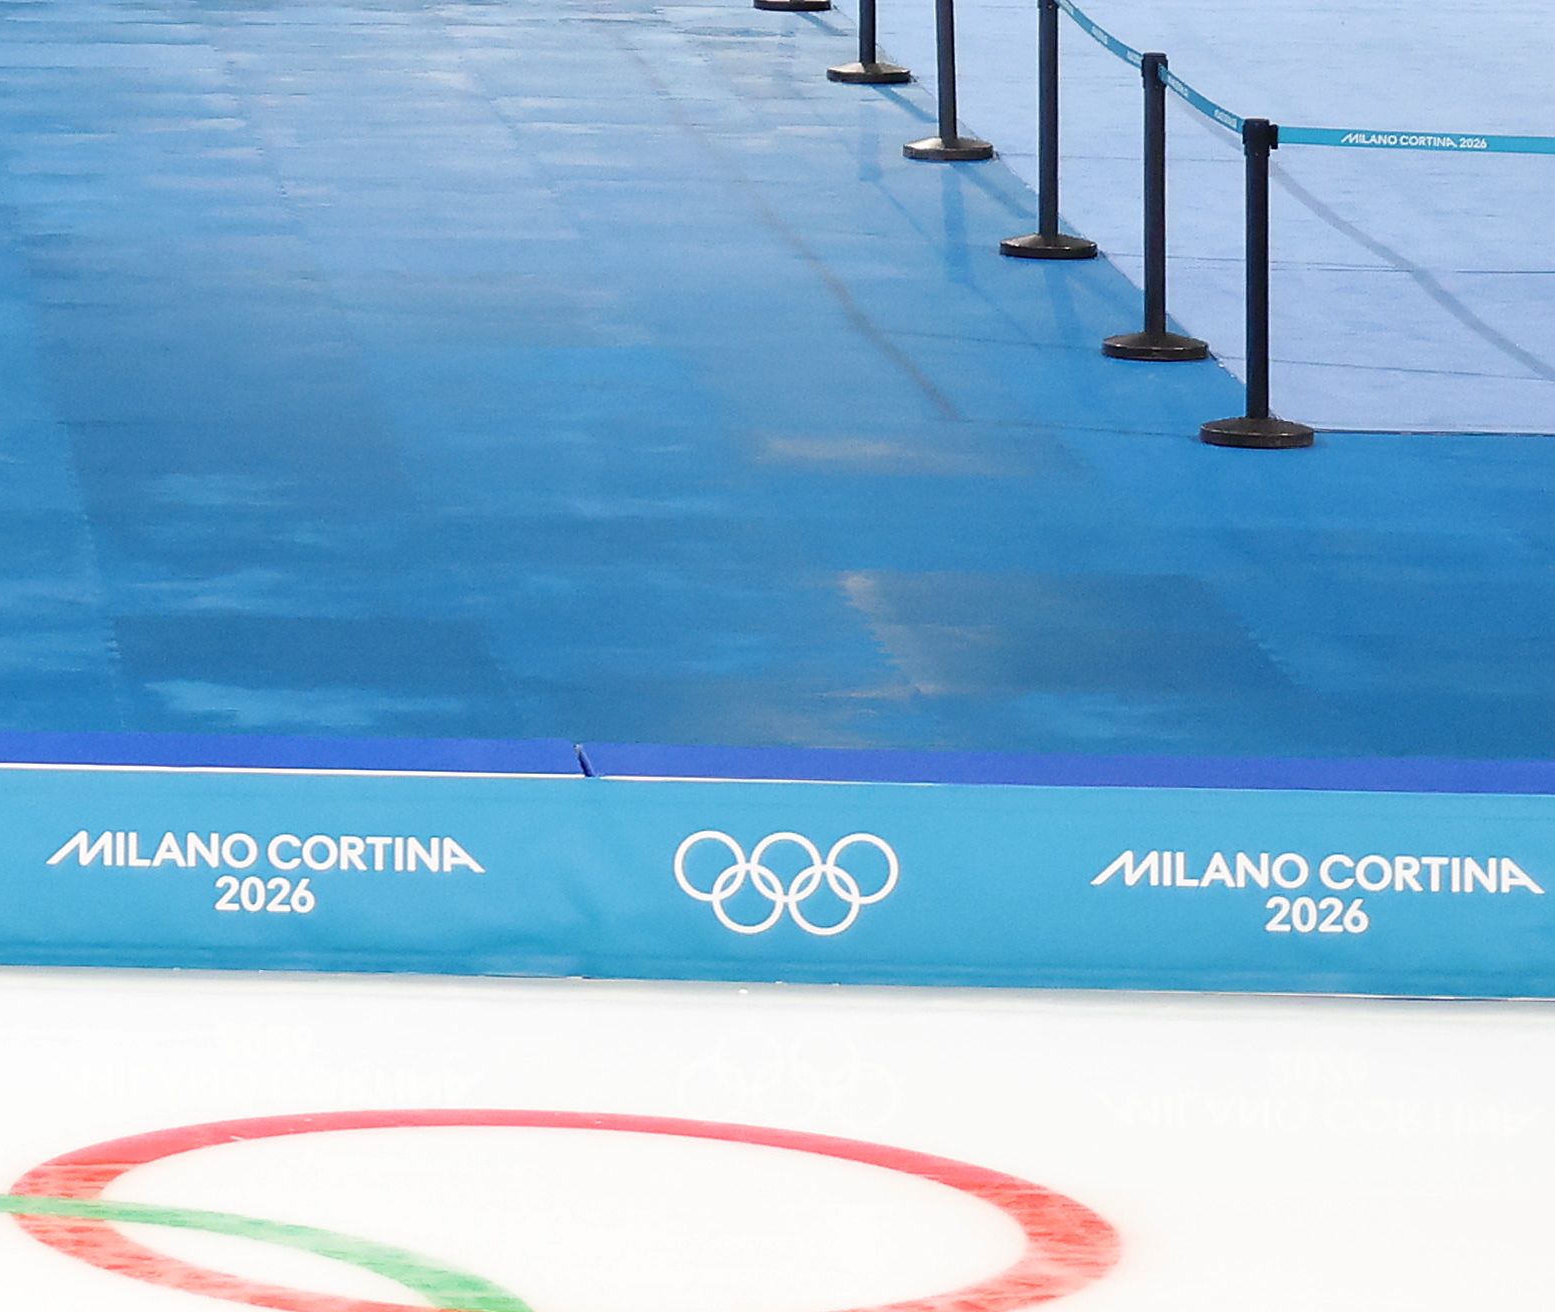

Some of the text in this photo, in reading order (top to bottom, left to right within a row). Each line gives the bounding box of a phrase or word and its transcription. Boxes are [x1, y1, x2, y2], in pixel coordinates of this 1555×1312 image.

[1340, 132, 1487, 149] MILANO CORTINA 2026
[46, 831, 485, 873] MILANO CORTINA
[1091, 851, 1545, 894] MILANO CORTINA
[215, 876, 315, 913] 2026
[1266, 896, 1369, 933] 2026
